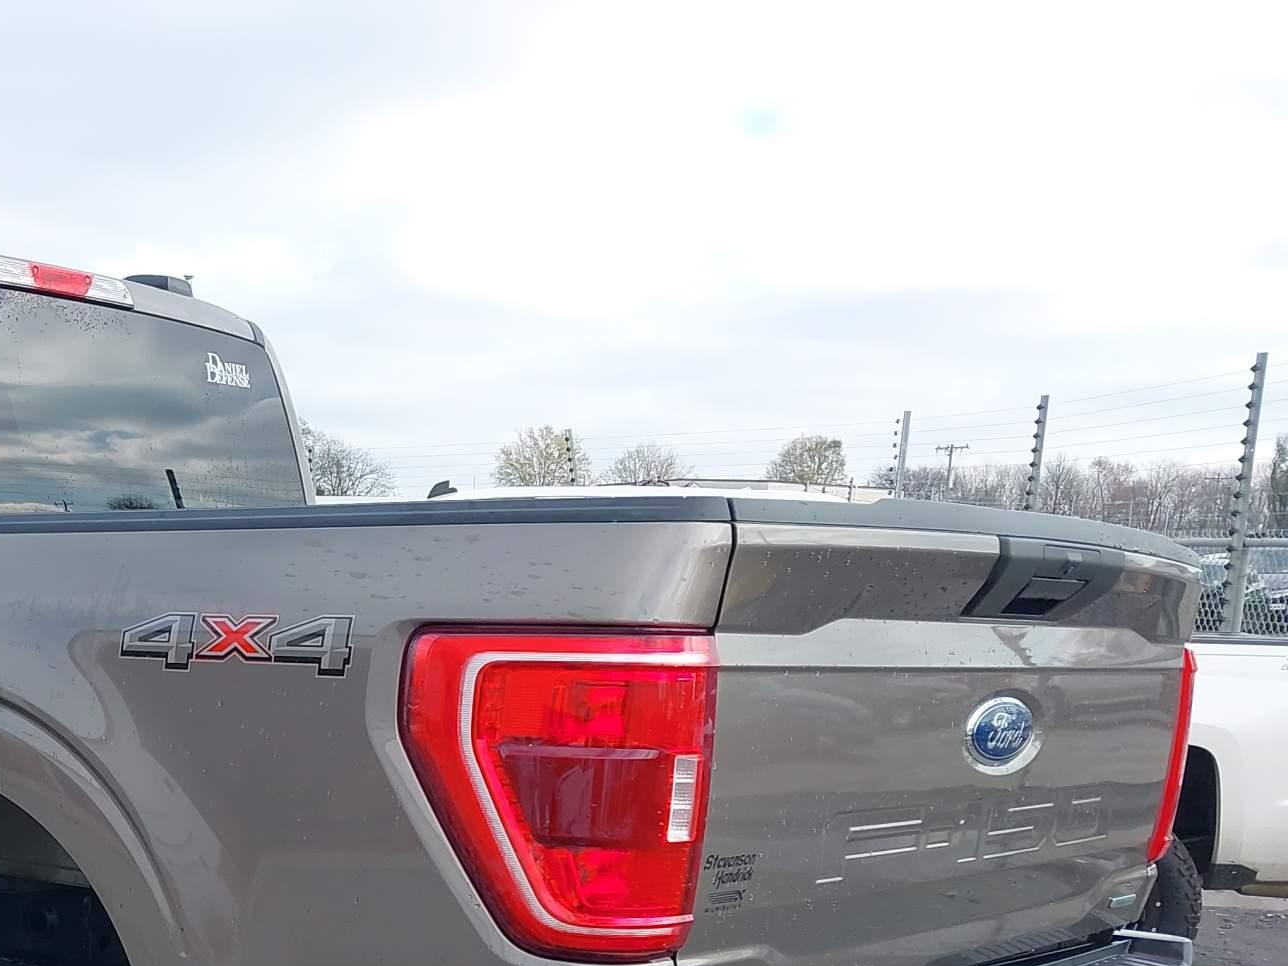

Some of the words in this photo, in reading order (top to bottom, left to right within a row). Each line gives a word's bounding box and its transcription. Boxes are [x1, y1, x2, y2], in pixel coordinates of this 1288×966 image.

[204, 362, 251, 389] DEFENSE
[207, 352, 249, 377] DANIEL
[987, 712, 1025, 749] Ford
